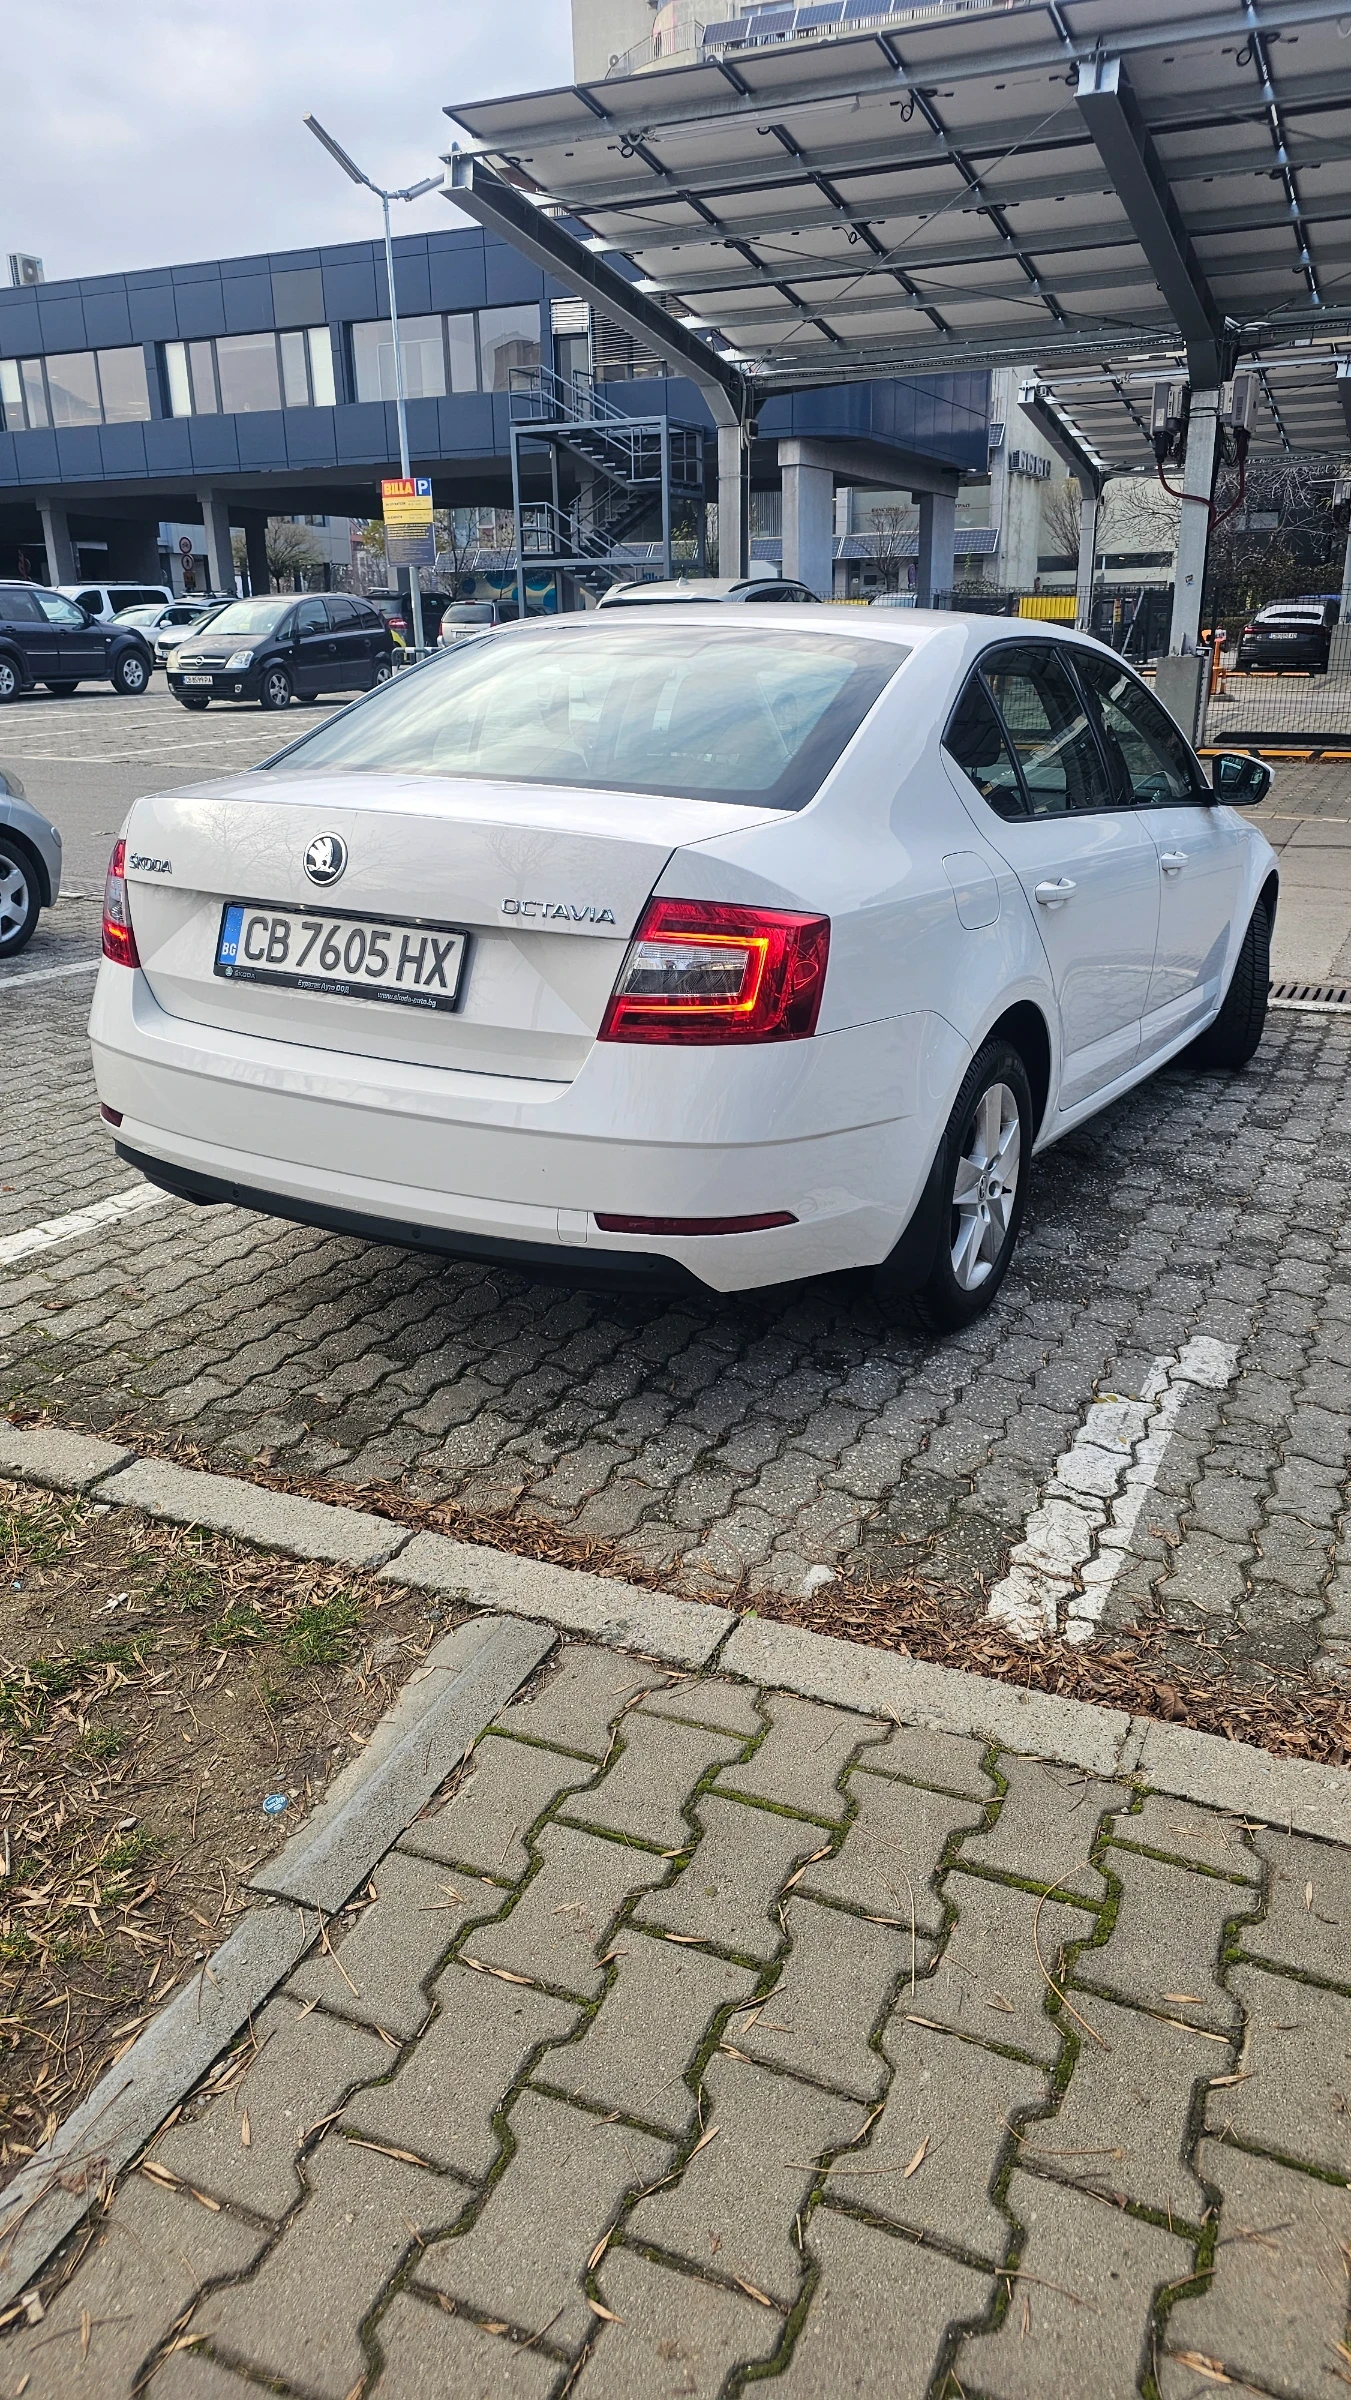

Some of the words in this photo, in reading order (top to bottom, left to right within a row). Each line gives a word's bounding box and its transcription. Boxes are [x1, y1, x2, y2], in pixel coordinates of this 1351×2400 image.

[383, 481, 413, 496] BILLA
[417, 480, 428, 495] P
[501, 897, 616, 925] OCTAVIA
[221, 942, 237, 956] BG
[295, 921, 391, 978] 7605
[395, 934, 456, 988] HX
